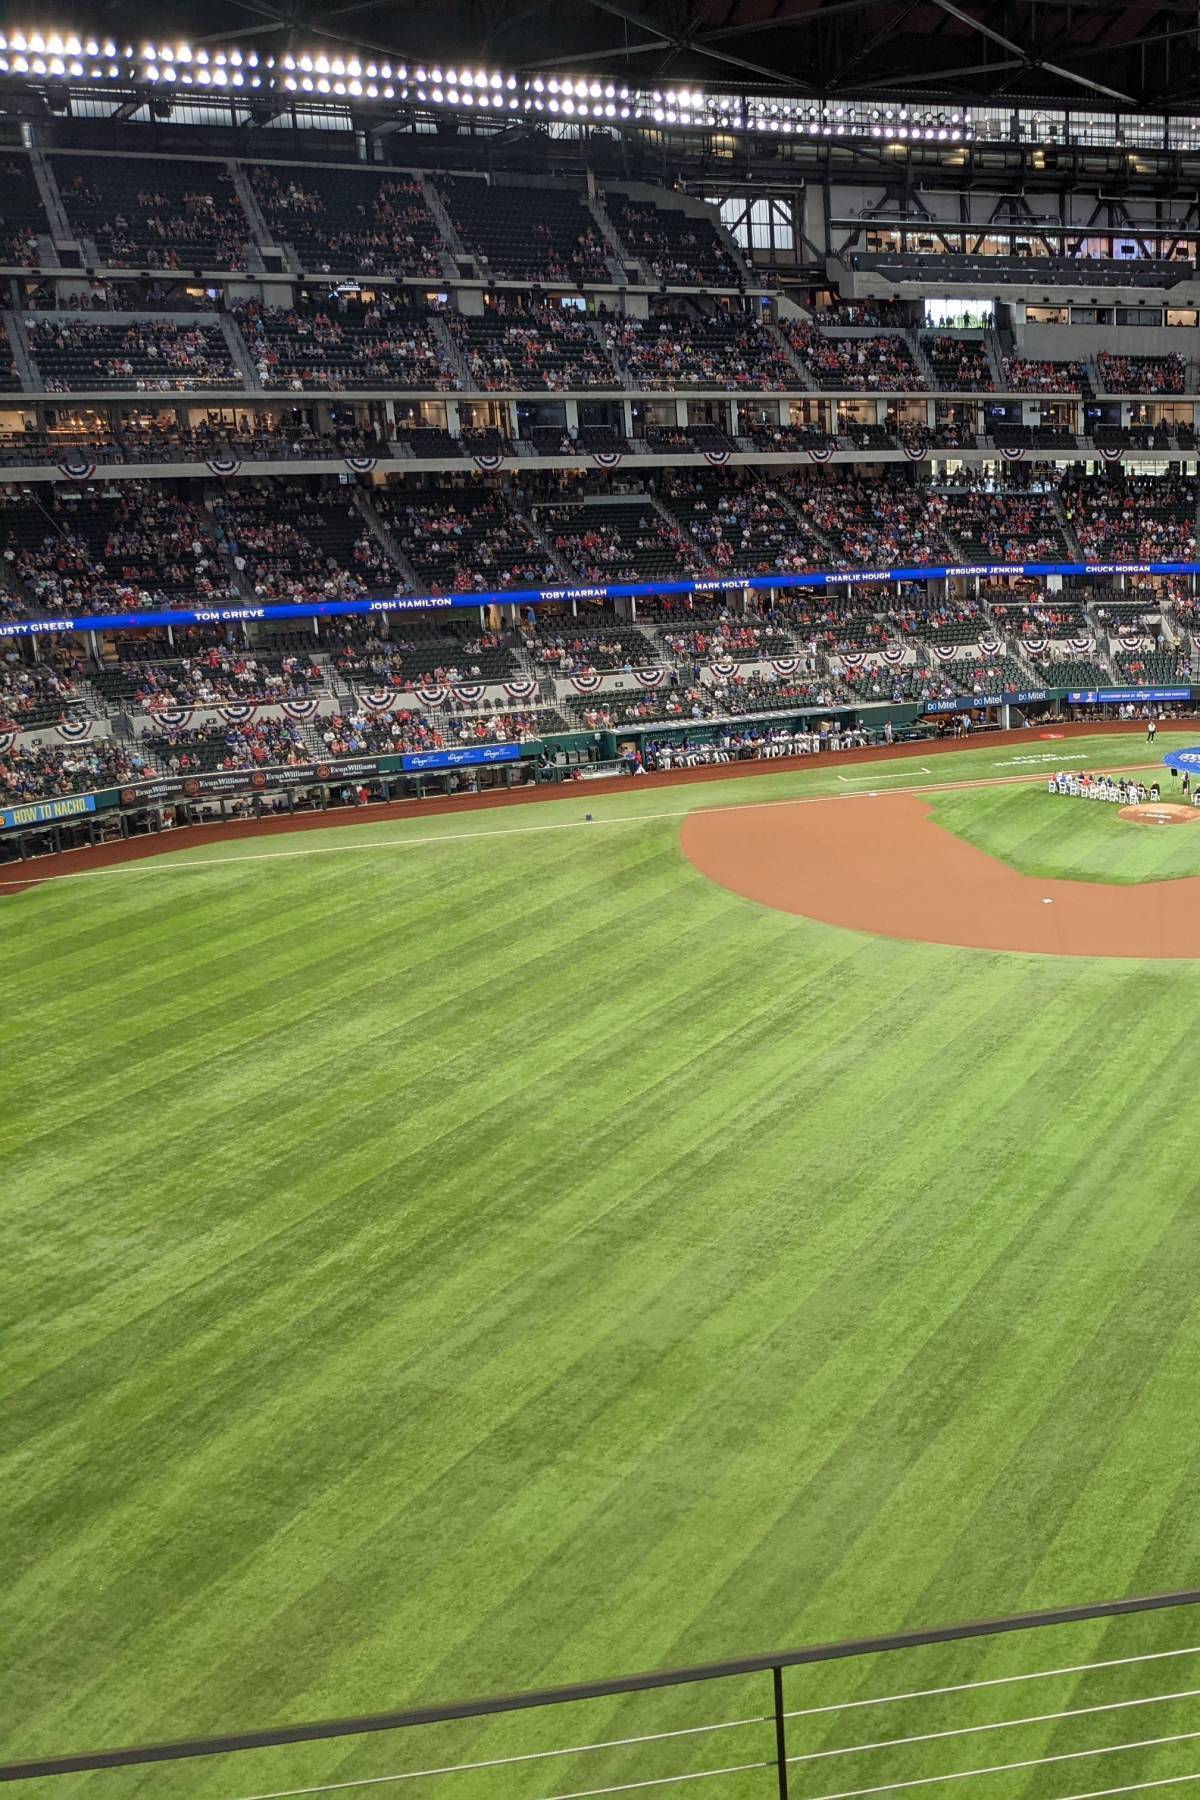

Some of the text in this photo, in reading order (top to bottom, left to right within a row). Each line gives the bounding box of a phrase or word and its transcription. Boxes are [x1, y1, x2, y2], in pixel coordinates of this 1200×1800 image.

[946, 566, 1024, 575] FERGUSON JENKINS
[825, 572, 891, 583] CHARLIE HOUGH
[695, 580, 750, 590] MARK HOLTZ
[540, 588, 607, 599] TOBY HARRAH
[369, 598, 452, 610] JOSH HAMILTON
[194, 609, 264, 621] TOM GRIEVE
[0, 625, 28, 635] USTY
[983, 695, 1002, 705] Mitel
[1027, 690, 1046, 700] Mitel
[937, 699, 957, 710] Mitel
[13, 808, 37, 824] HOW
[40, 805, 52, 819] TO
[54, 798, 89, 817] NACHO.
